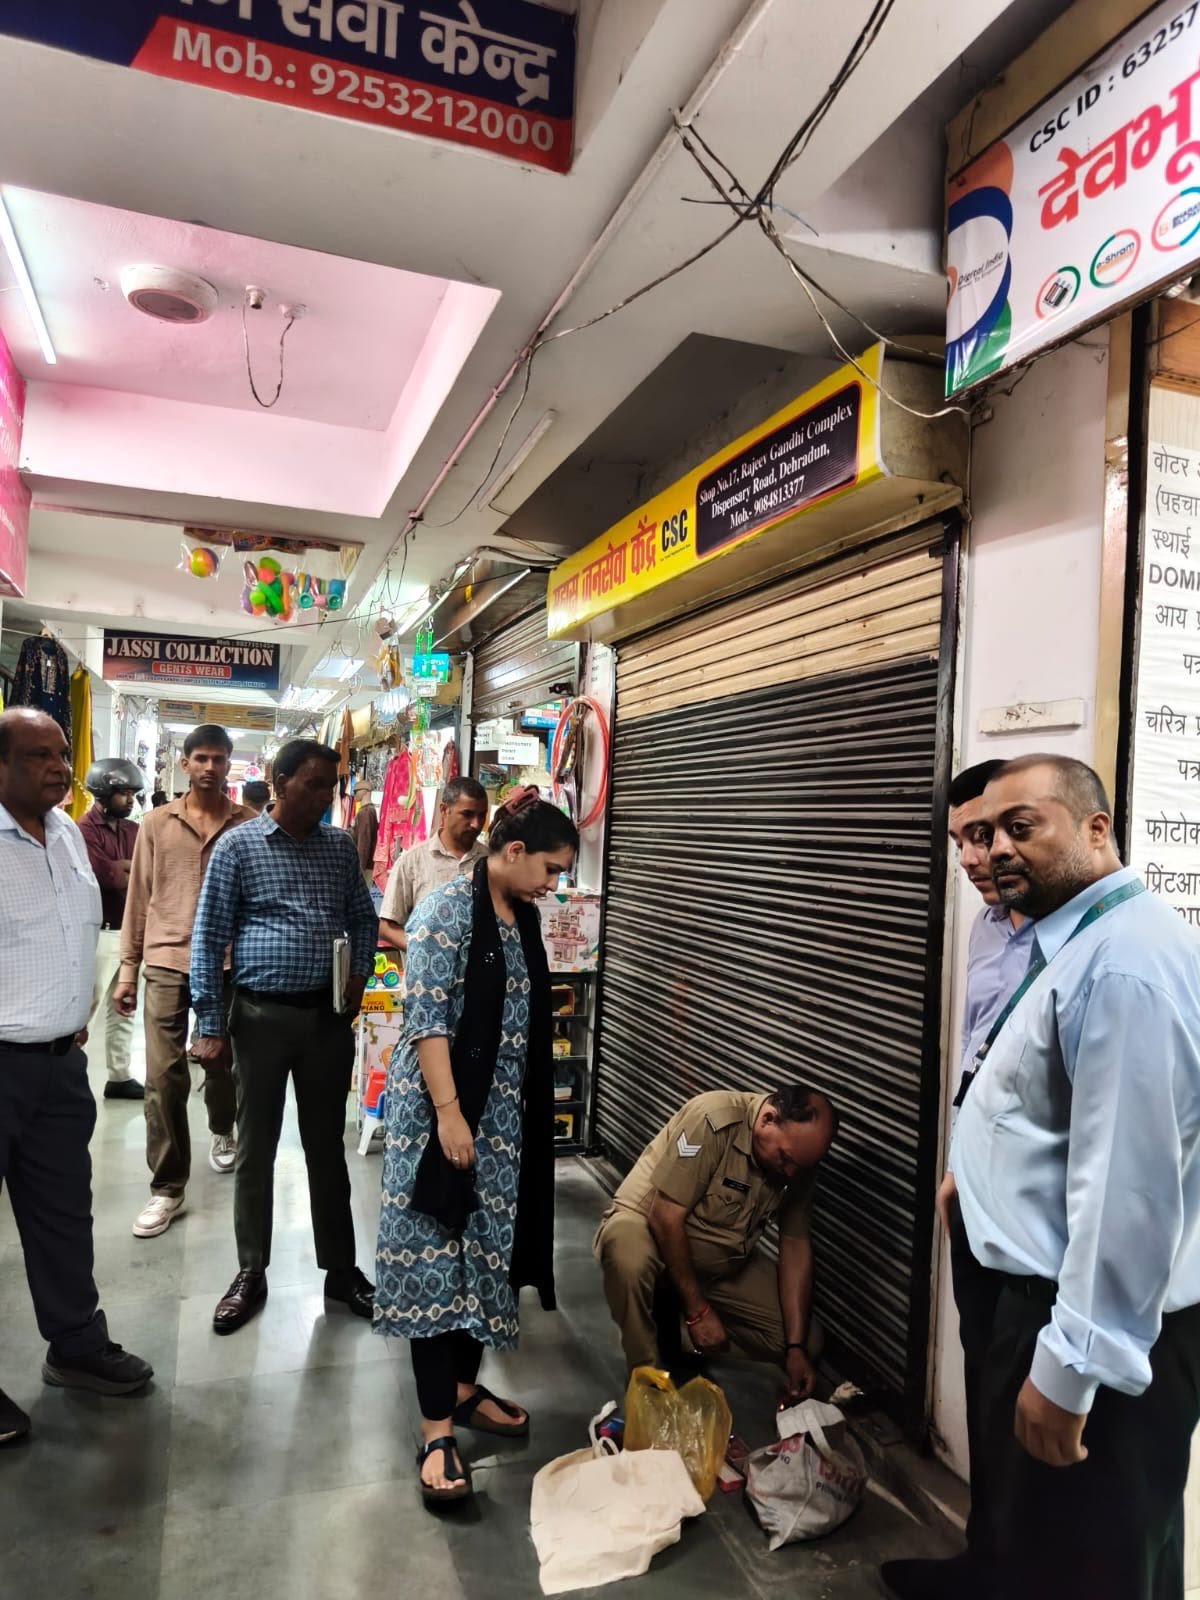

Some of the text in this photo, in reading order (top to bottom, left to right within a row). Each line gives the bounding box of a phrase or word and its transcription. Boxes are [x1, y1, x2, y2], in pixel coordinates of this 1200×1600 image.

[419, 0, 557, 107] केन्द्र
[173, 26, 554, 152] Mob.: 9253212000
[1029, 107, 1070, 153] CSC
[1077, 84, 1101, 117] ID
[1038, 54, 1200, 230] देवभू
[699, 484, 716, 506] Shop
[741, 454, 767, 480] Rajeev
[770, 427, 804, 461] Gandhi
[806, 404, 853, 439] Complex
[1153, 446, 1189, 477] वोटर
[712, 443, 830, 518] Dispensary Road, Dehradun,
[754, 475, 805, 516] 9084813377
[662, 509, 688, 552] CSC
[1152, 527, 1191, 559] स्थाई
[1155, 604, 1188, 629] आय
[107, 638, 274, 667] JASSI COLLECTION
[159, 664, 225, 677] GENTS WEAR
[1145, 705, 1187, 735] चरित्र
[1144, 862, 1200, 894] प्रिंटआ
